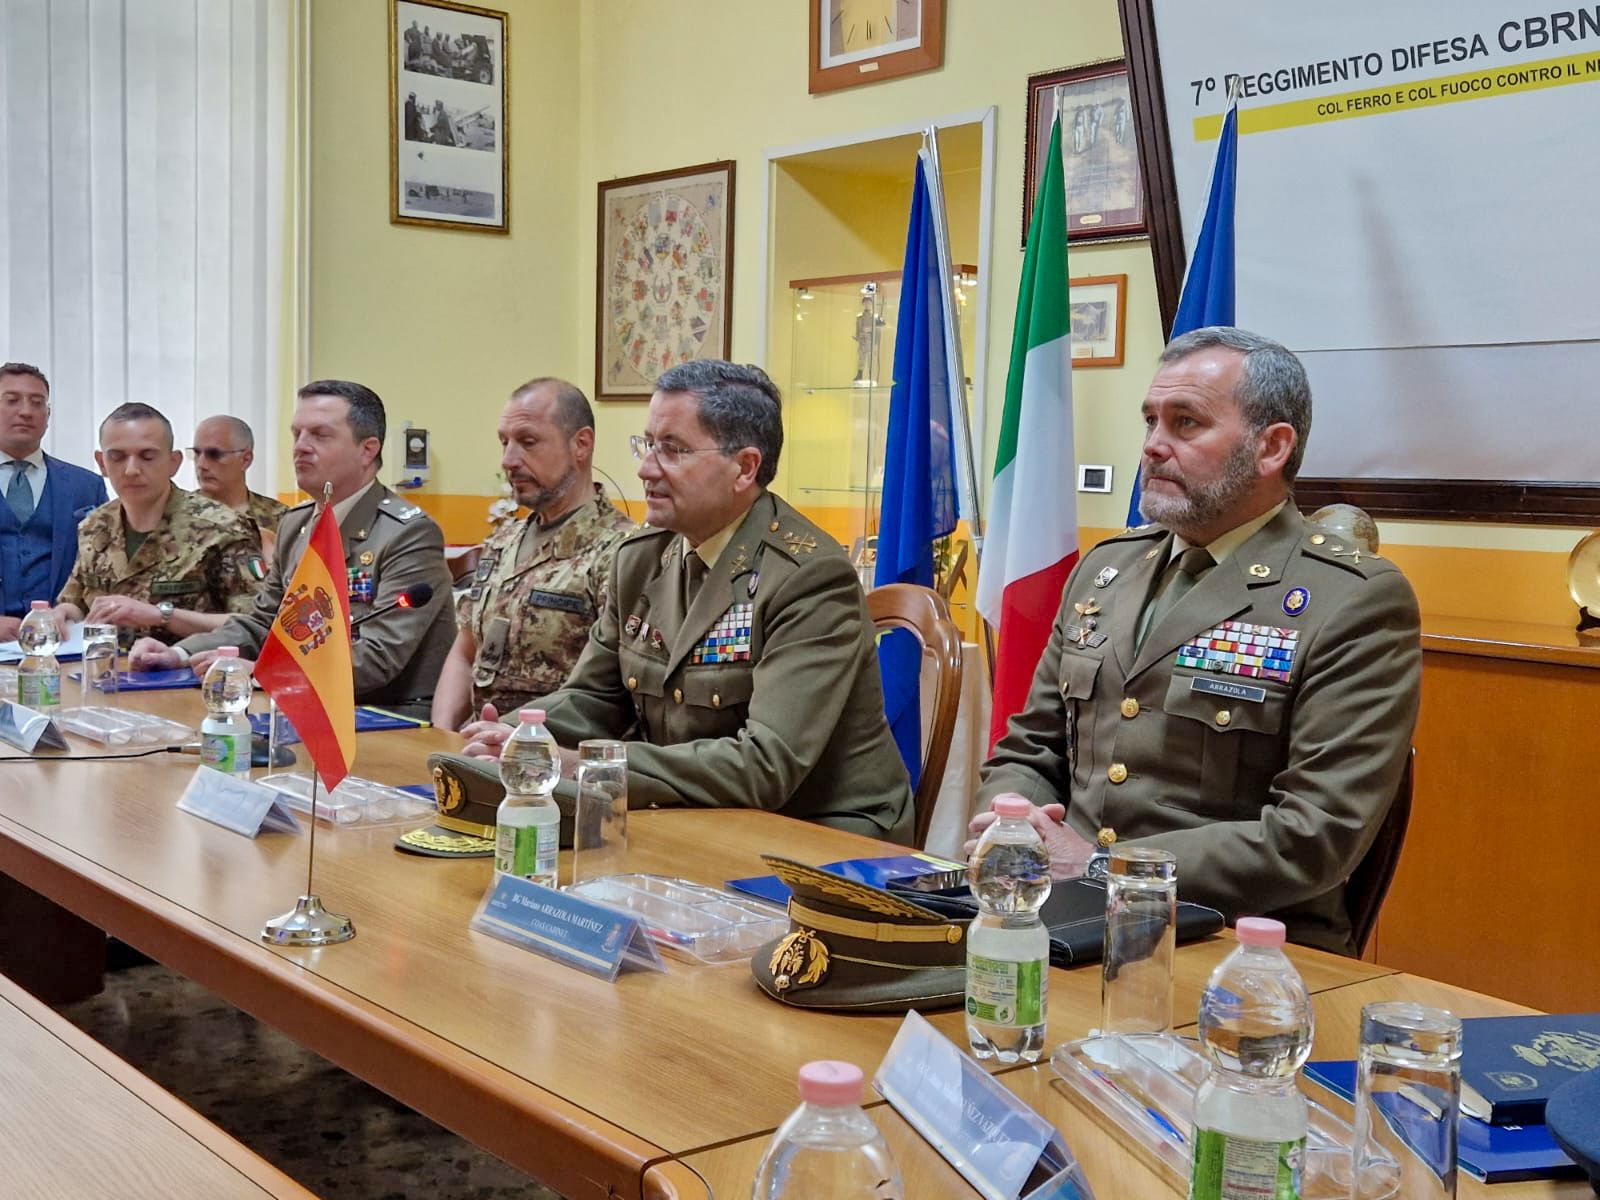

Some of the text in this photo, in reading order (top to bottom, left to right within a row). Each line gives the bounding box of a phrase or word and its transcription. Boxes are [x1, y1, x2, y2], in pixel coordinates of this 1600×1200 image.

[1223, 53, 1383, 99] REGGIMENTO
[1391, 34, 1489, 72] DIFESA
[1498, 5, 1600, 52] CBRN
[1317, 102, 1343, 116] COL
[1347, 92, 1391, 113] FERRO
[1396, 91, 1404, 104] E
[1408, 86, 1436, 102] COL
[1441, 77, 1492, 98] FUOCO
[1496, 65, 1562, 88] CONTRO
[1567, 63, 1581, 76] IL
[1209, 683, 1247, 696] ARRAZOLA
[570, 912, 604, 934] MARTÍNEZ
